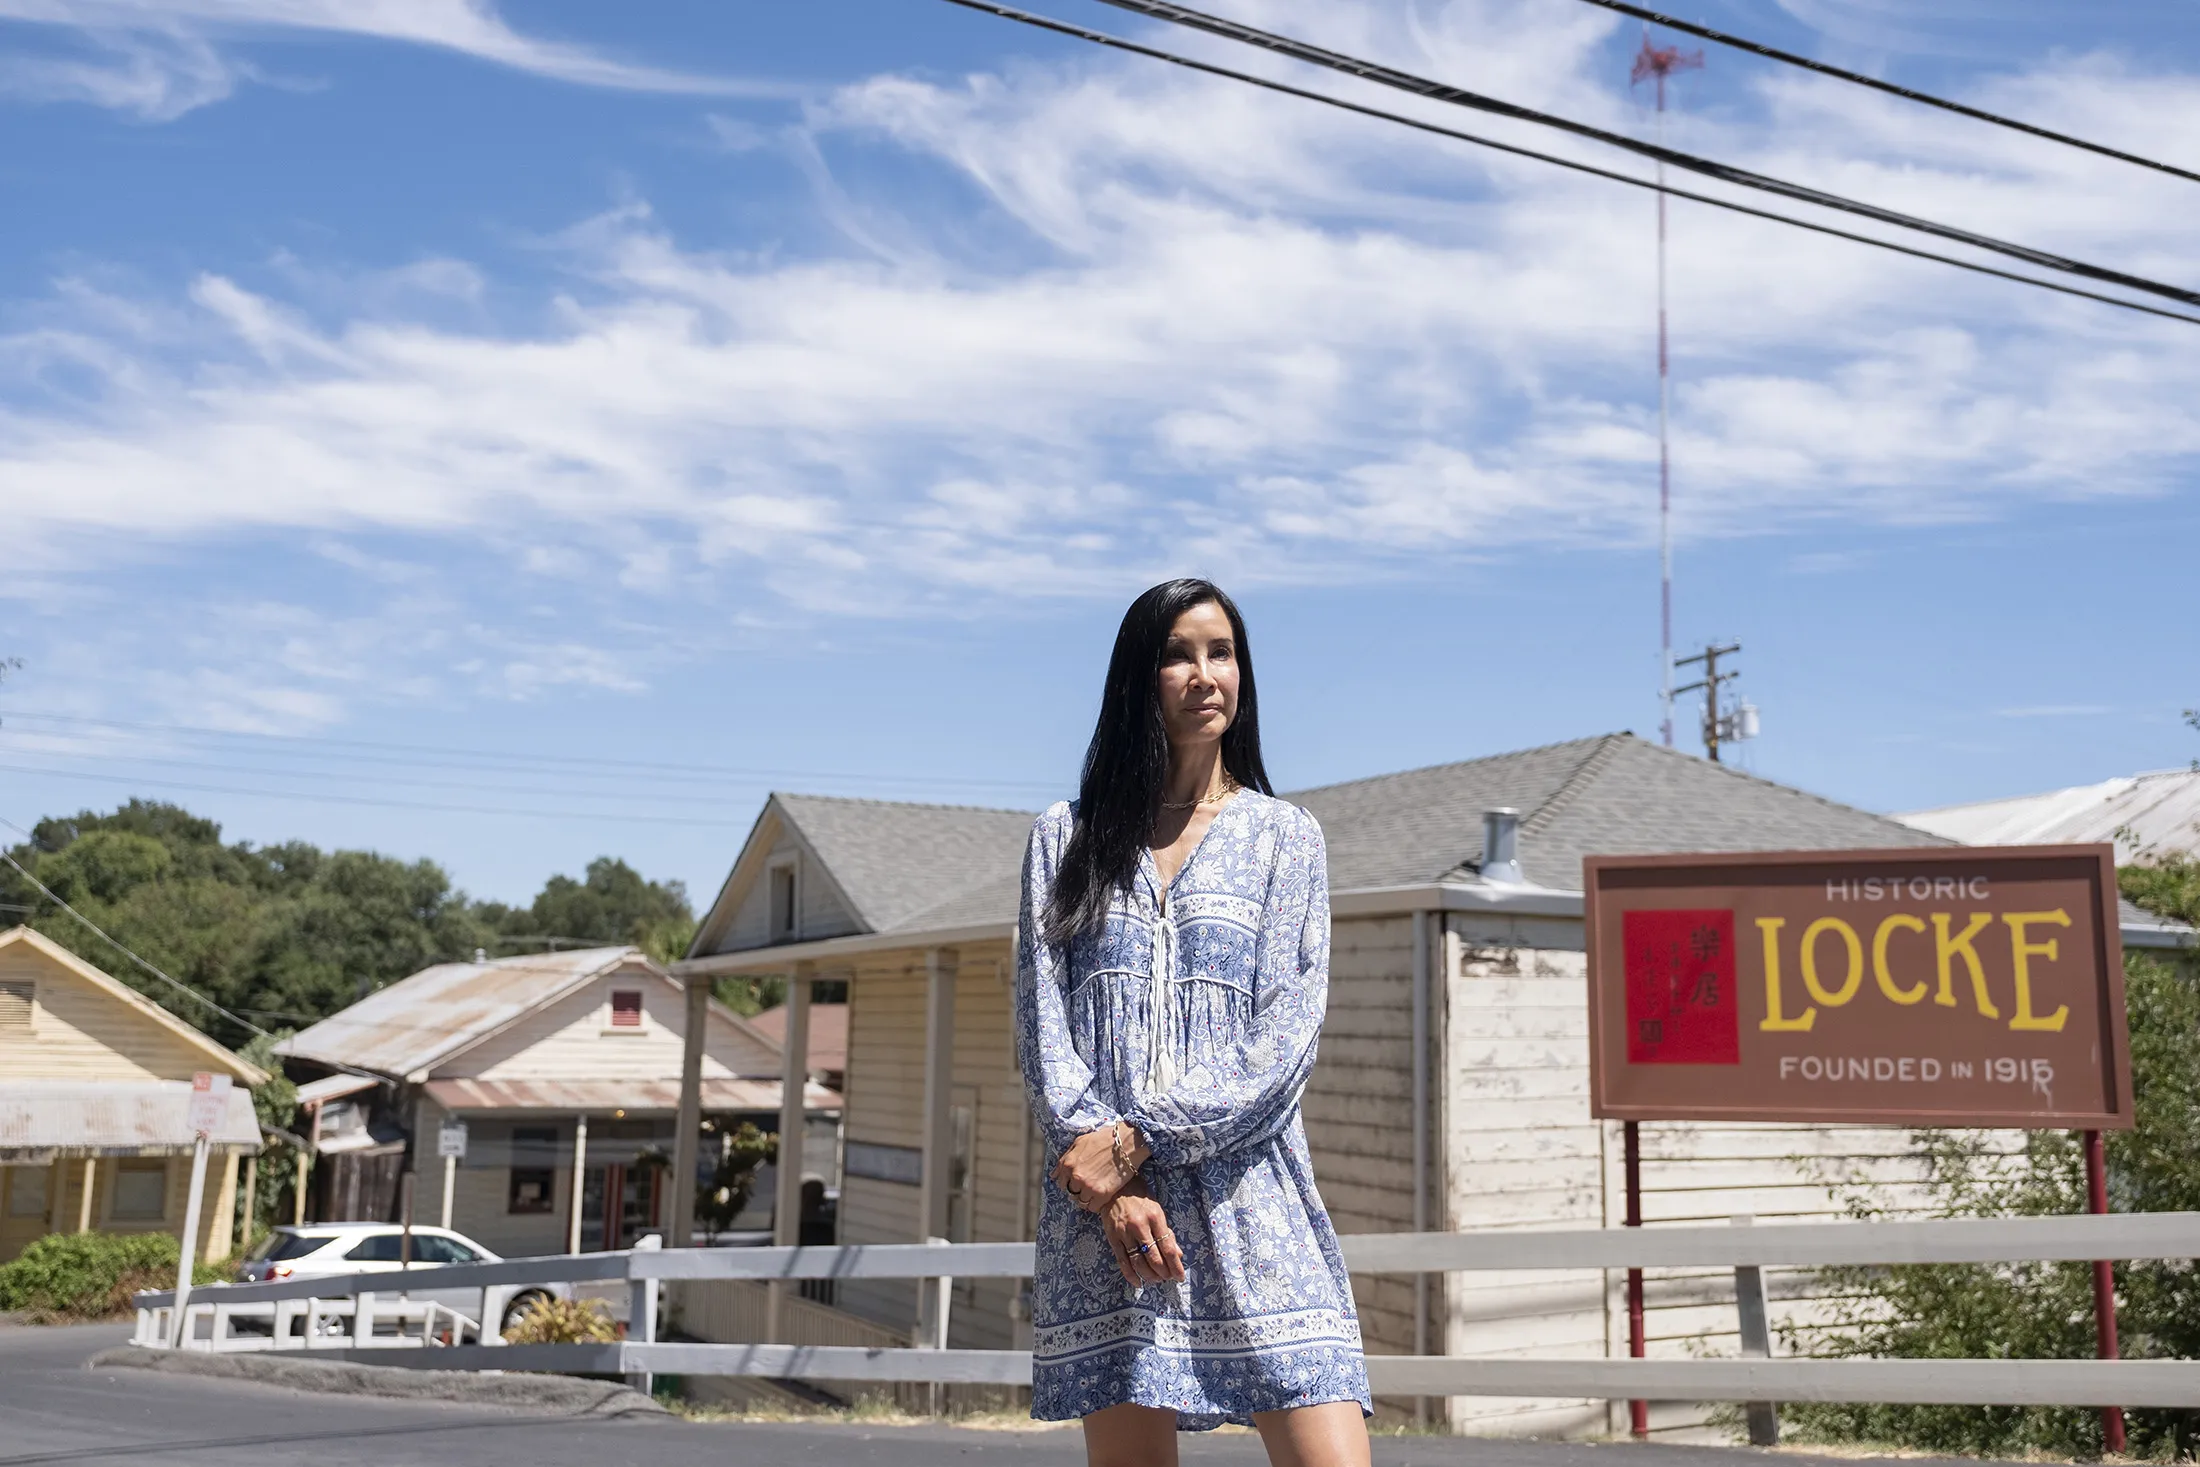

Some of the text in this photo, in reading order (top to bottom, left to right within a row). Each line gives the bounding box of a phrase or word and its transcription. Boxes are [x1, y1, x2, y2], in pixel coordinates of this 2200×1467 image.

[1826, 876, 1990, 901] HISTORIC
[1755, 908, 2072, 1032] LOCKE
[1780, 1056, 1941, 1081] FOUNDED
[1951, 1061, 1973, 1079] IN
